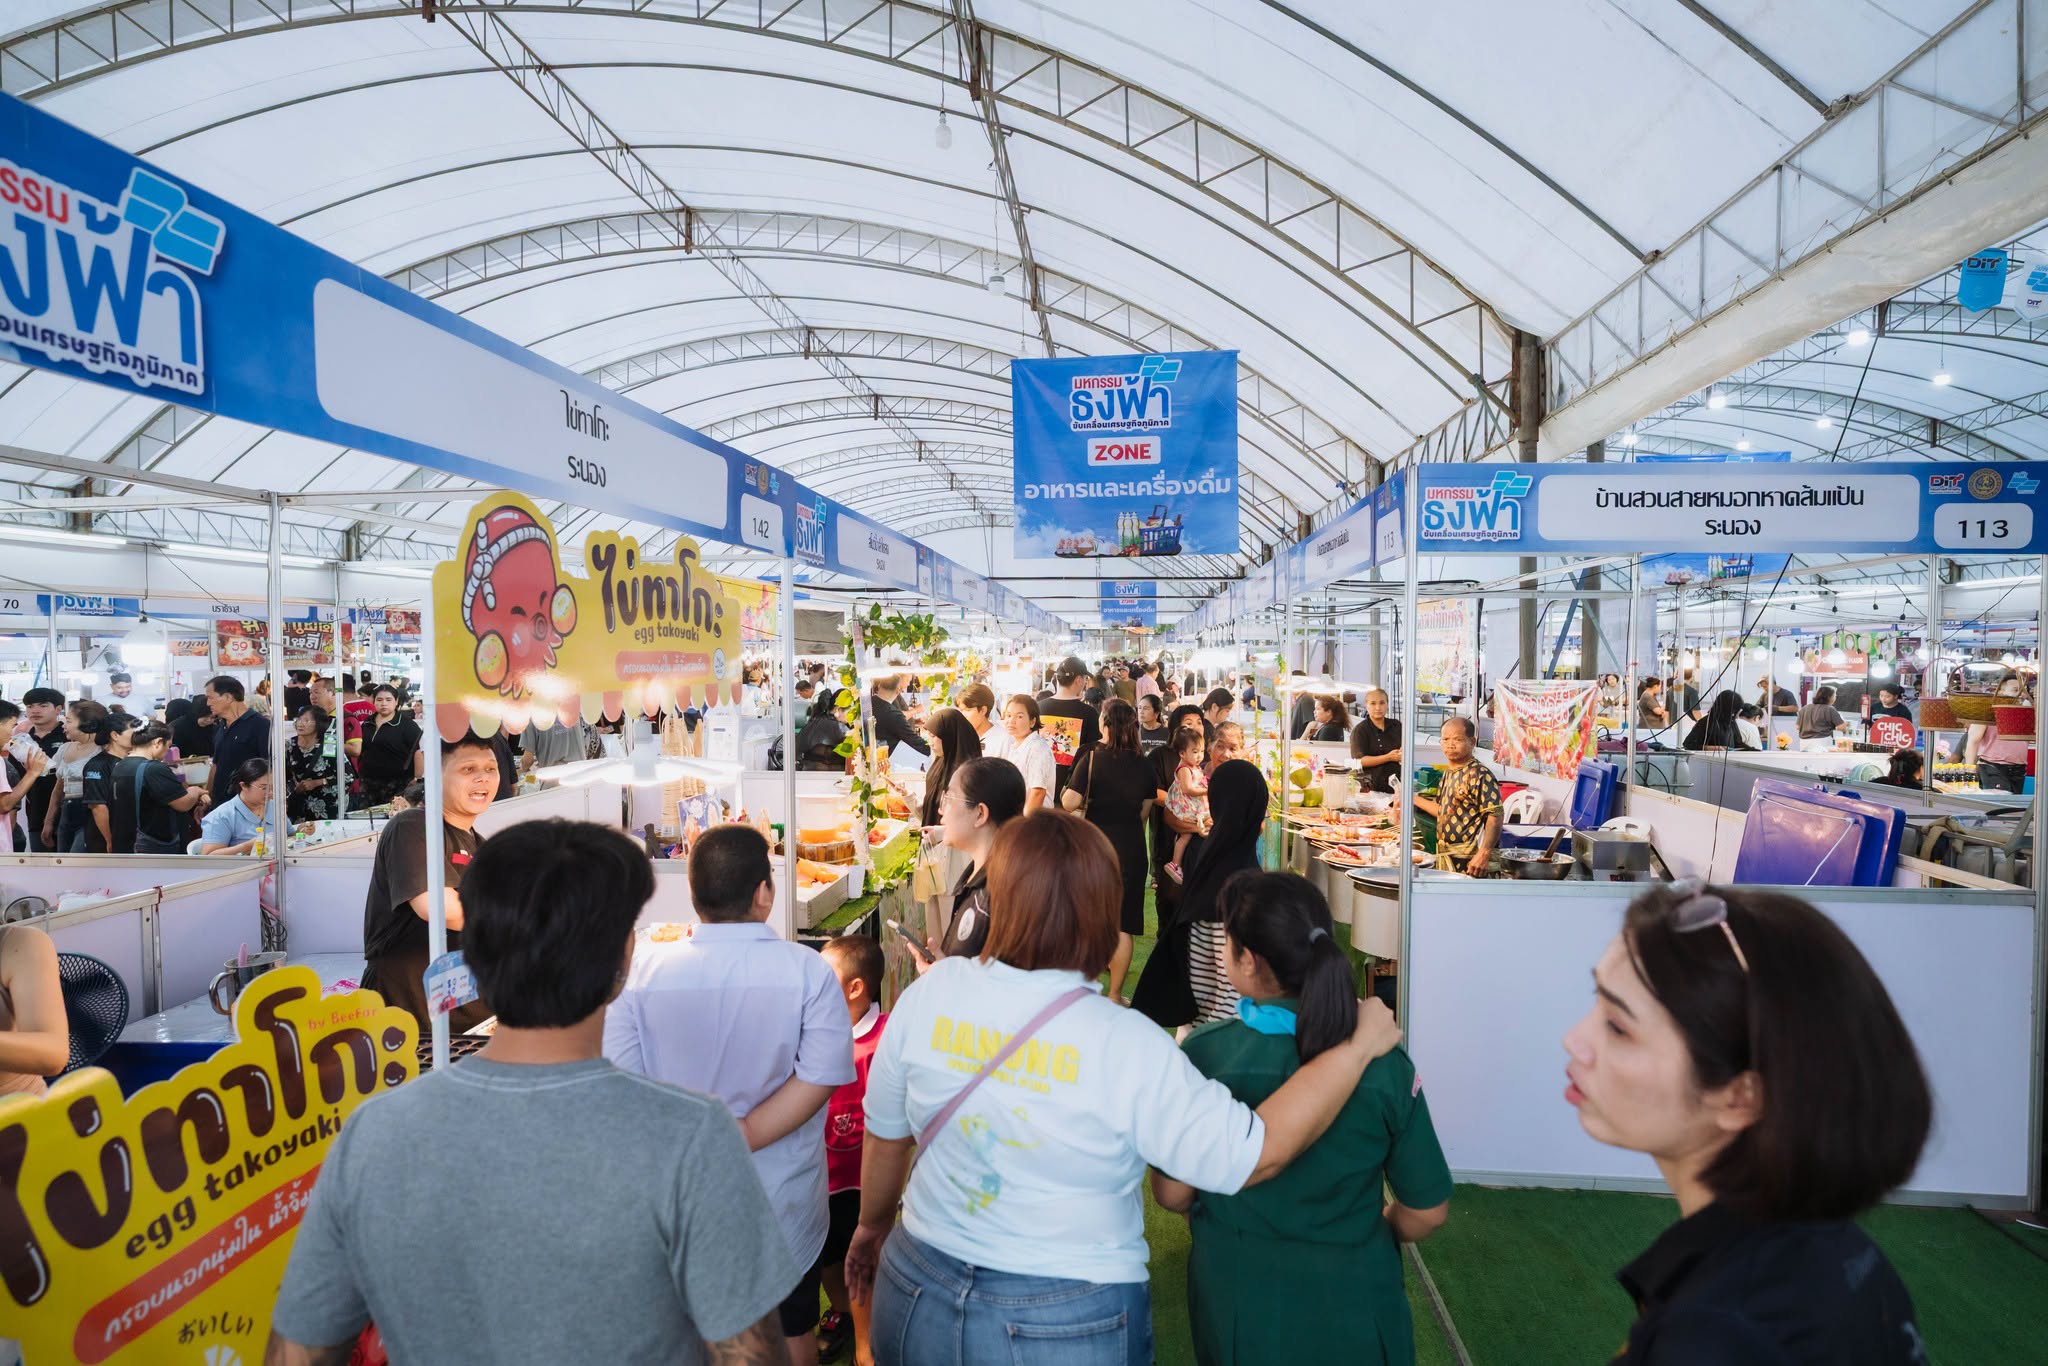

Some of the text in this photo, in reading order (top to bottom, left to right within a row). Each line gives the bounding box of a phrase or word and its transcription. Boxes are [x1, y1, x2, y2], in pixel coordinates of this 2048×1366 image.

[1074, 377, 1123, 389] มหกรรม
[1072, 376, 1169, 421] ธงฟ้า
[1072, 417, 1170, 430] ขับเคลื่อนเศรษฐกิจภูมิภาค
[1094, 443, 1152, 461] ZONE
[567, 455, 607, 488] ระนอง
[1024, 467, 1231, 499] อาหารและเครื่องดื่ม
[1427, 488, 1474, 500] มหกรรม
[1595, 485, 1864, 508] บ้านสวนสายหมอกหาดส้มแป้น
[1424, 488, 1518, 531] ธงฟ้า
[752, 517, 770, 539] 142
[1704, 519, 1762, 536] ระนอง
[1957, 519, 2009, 539] 113
[1383, 531, 1395, 550] 113
[591, 543, 723, 638] ไข่ทาโกะ
[634, 621, 700, 645] egg takoyaki
[231, 641, 249, 652] 59
[124, 1107, 343, 1259] egg takoyaki
[105, 1216, 263, 1343] กรอบนอกนุ่มใน
[178, 1310, 255, 1345] おいしい
